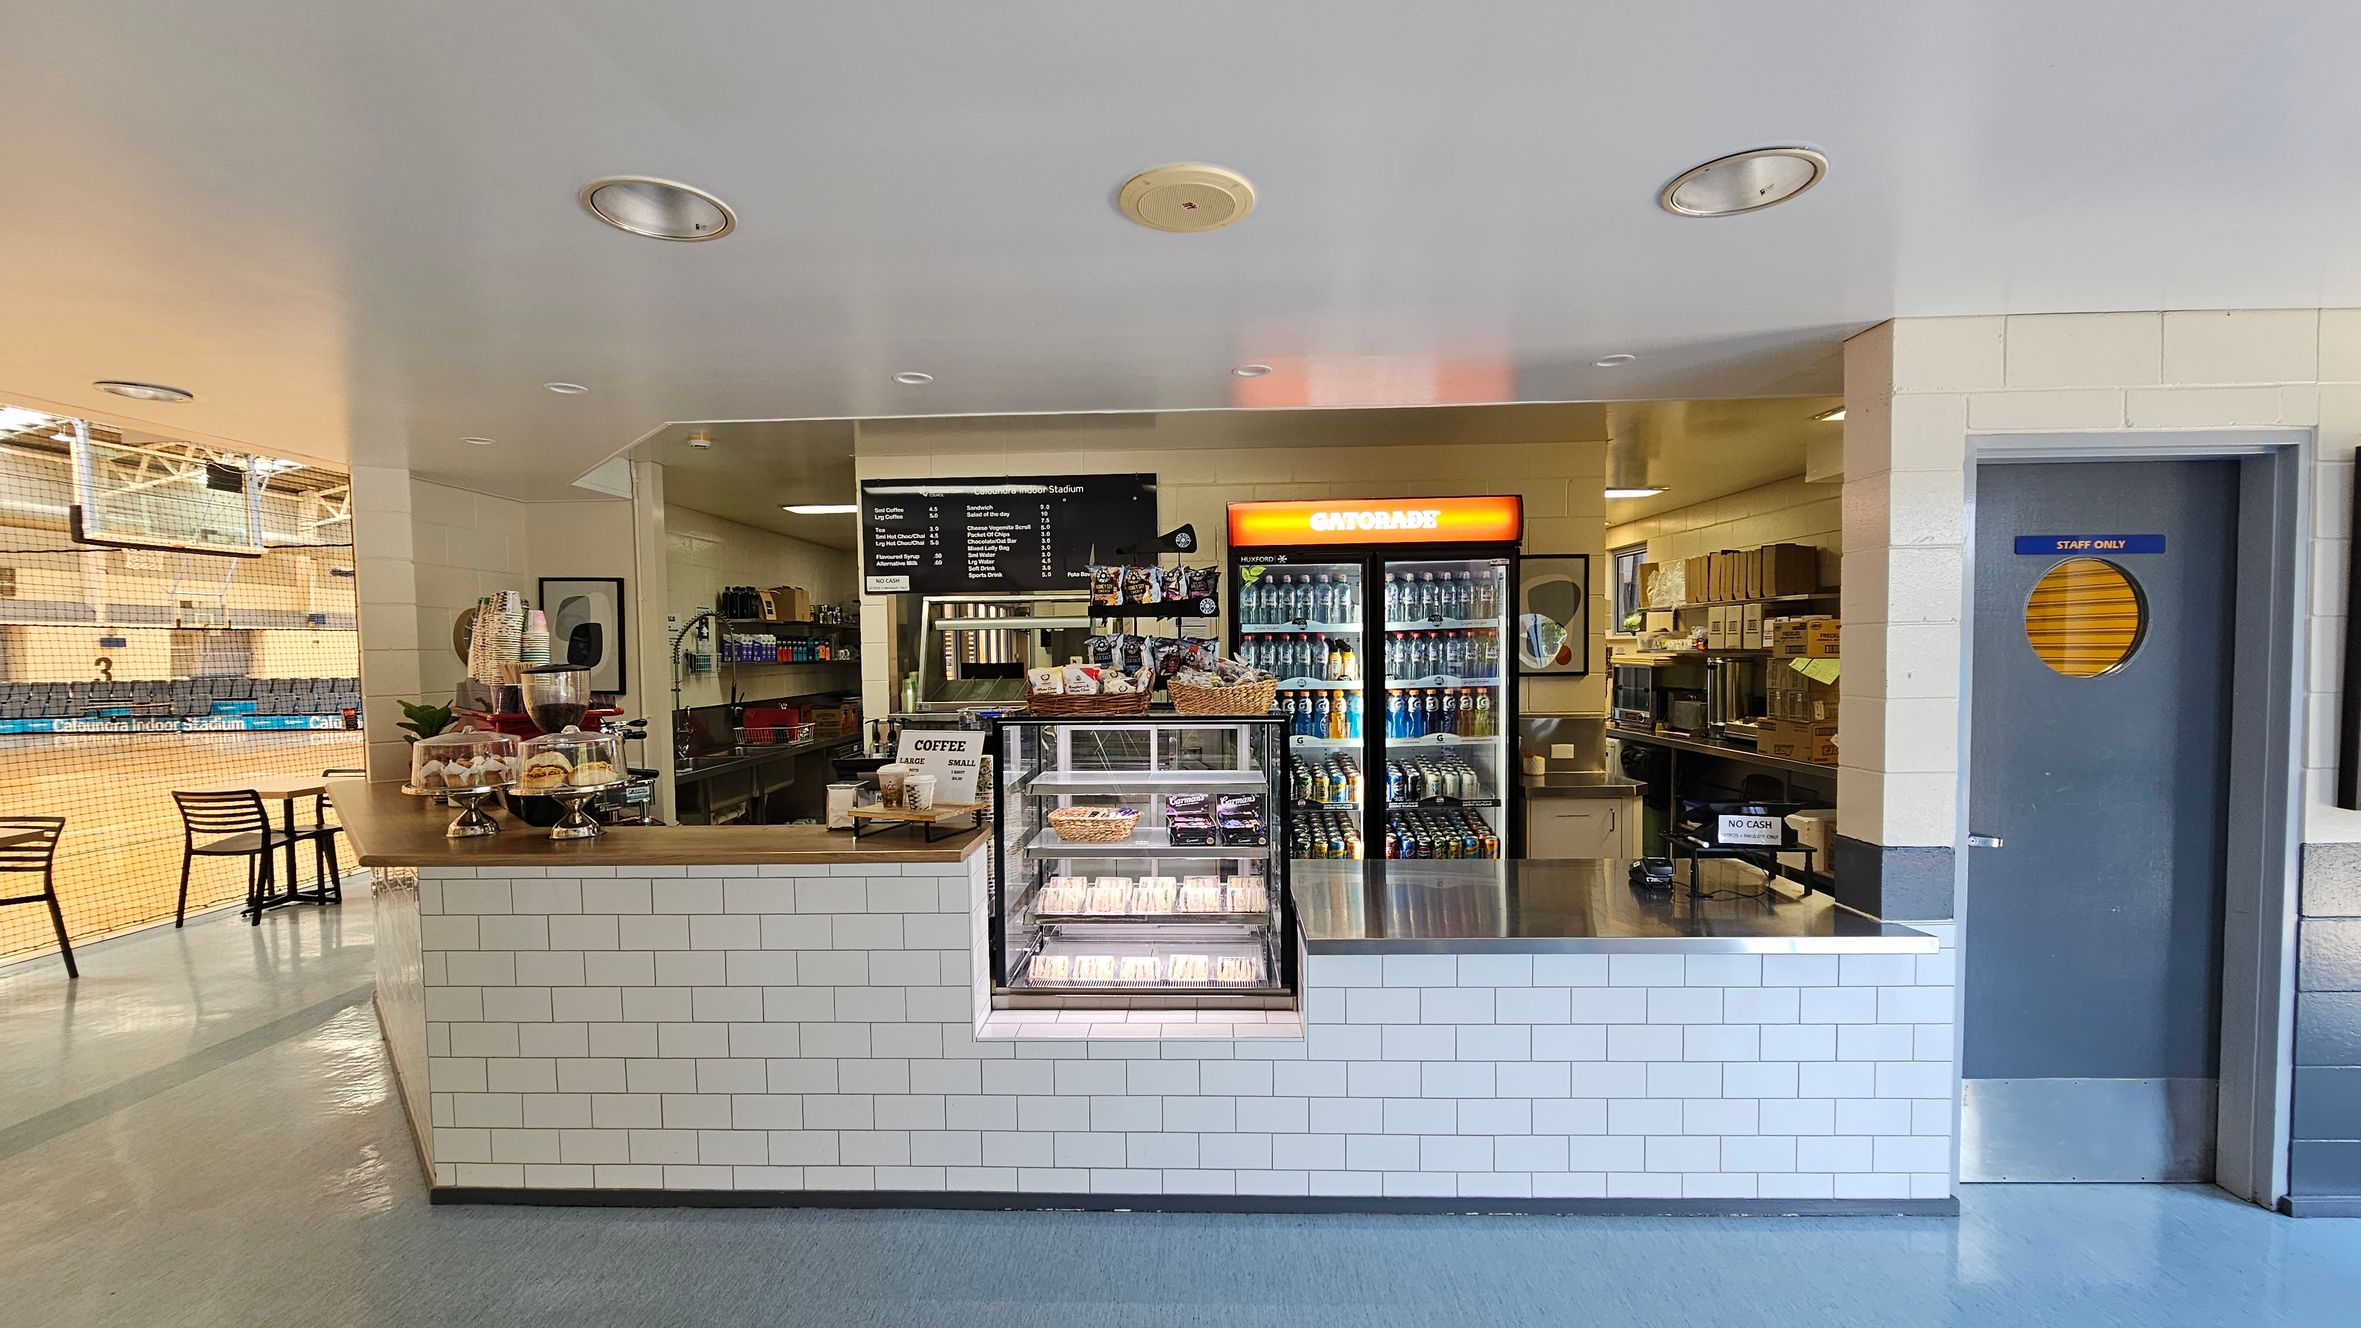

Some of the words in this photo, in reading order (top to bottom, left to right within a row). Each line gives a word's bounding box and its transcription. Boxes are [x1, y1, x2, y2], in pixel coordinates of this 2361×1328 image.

[1048, 485, 1084, 494] Stadium
[1309, 510, 1438, 530] GATORADE
[2056, 541, 2091, 549] STAFF
[2094, 540, 2126, 549] ONLY
[94, 656, 112, 681] 3
[54, 718, 128, 732] Caloundra
[132, 717, 179, 731] Indoor
[183, 714, 245, 730] Stadium
[915, 740, 966, 752] COFFEE
[1747, 820, 1772, 829] CASH
